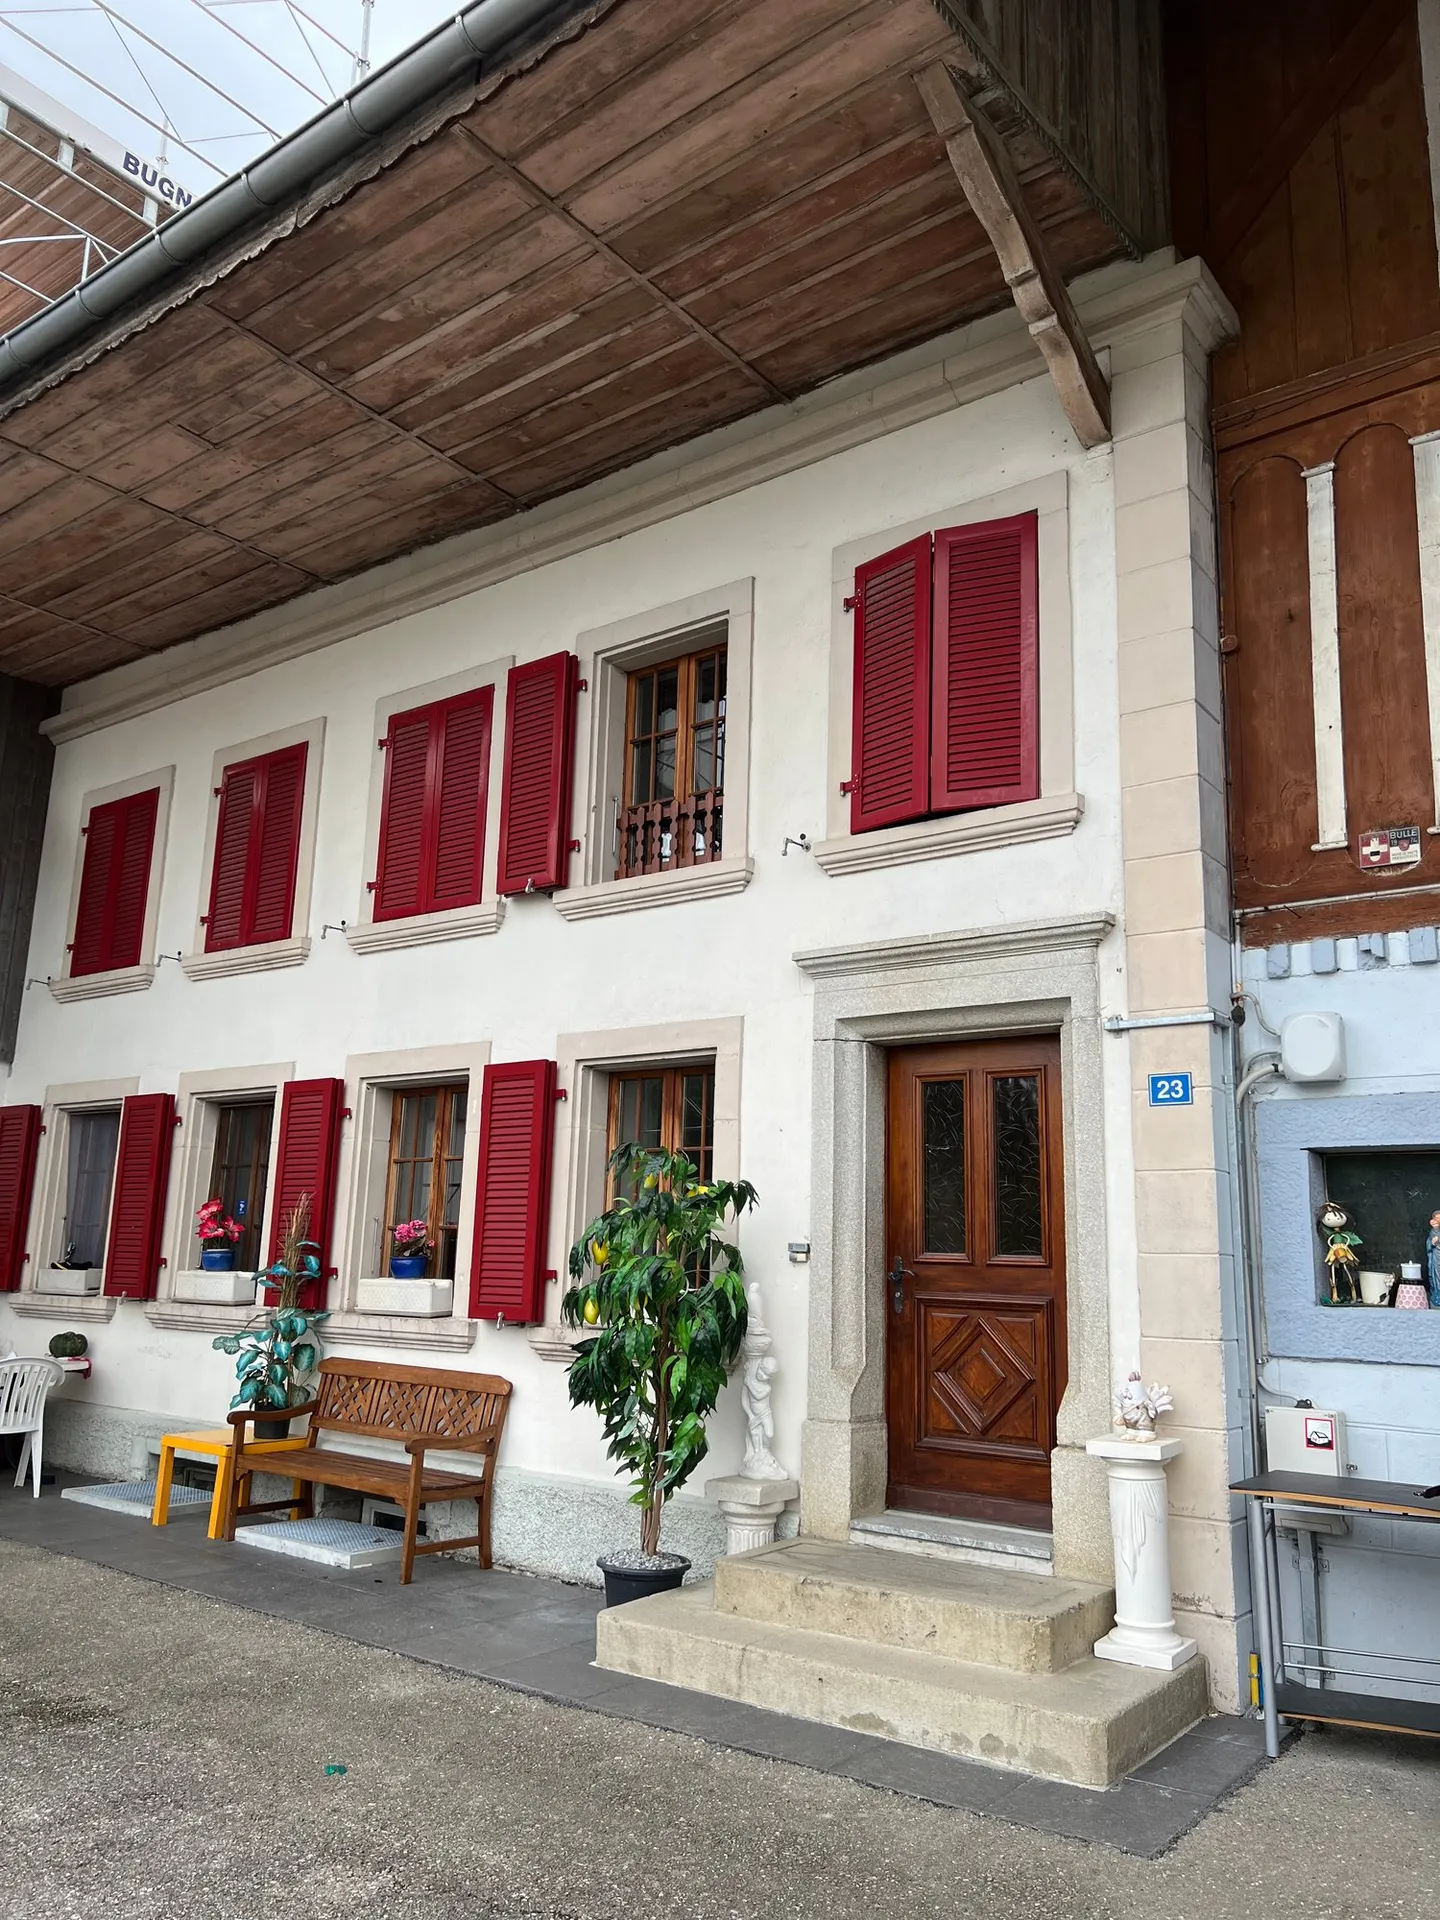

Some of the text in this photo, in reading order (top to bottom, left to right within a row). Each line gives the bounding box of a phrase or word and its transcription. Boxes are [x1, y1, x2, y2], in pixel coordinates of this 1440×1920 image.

[123, 151, 192, 208] BUGN
[1389, 829, 1418, 839] BULLE
[1157, 1080, 1184, 1099] 23
